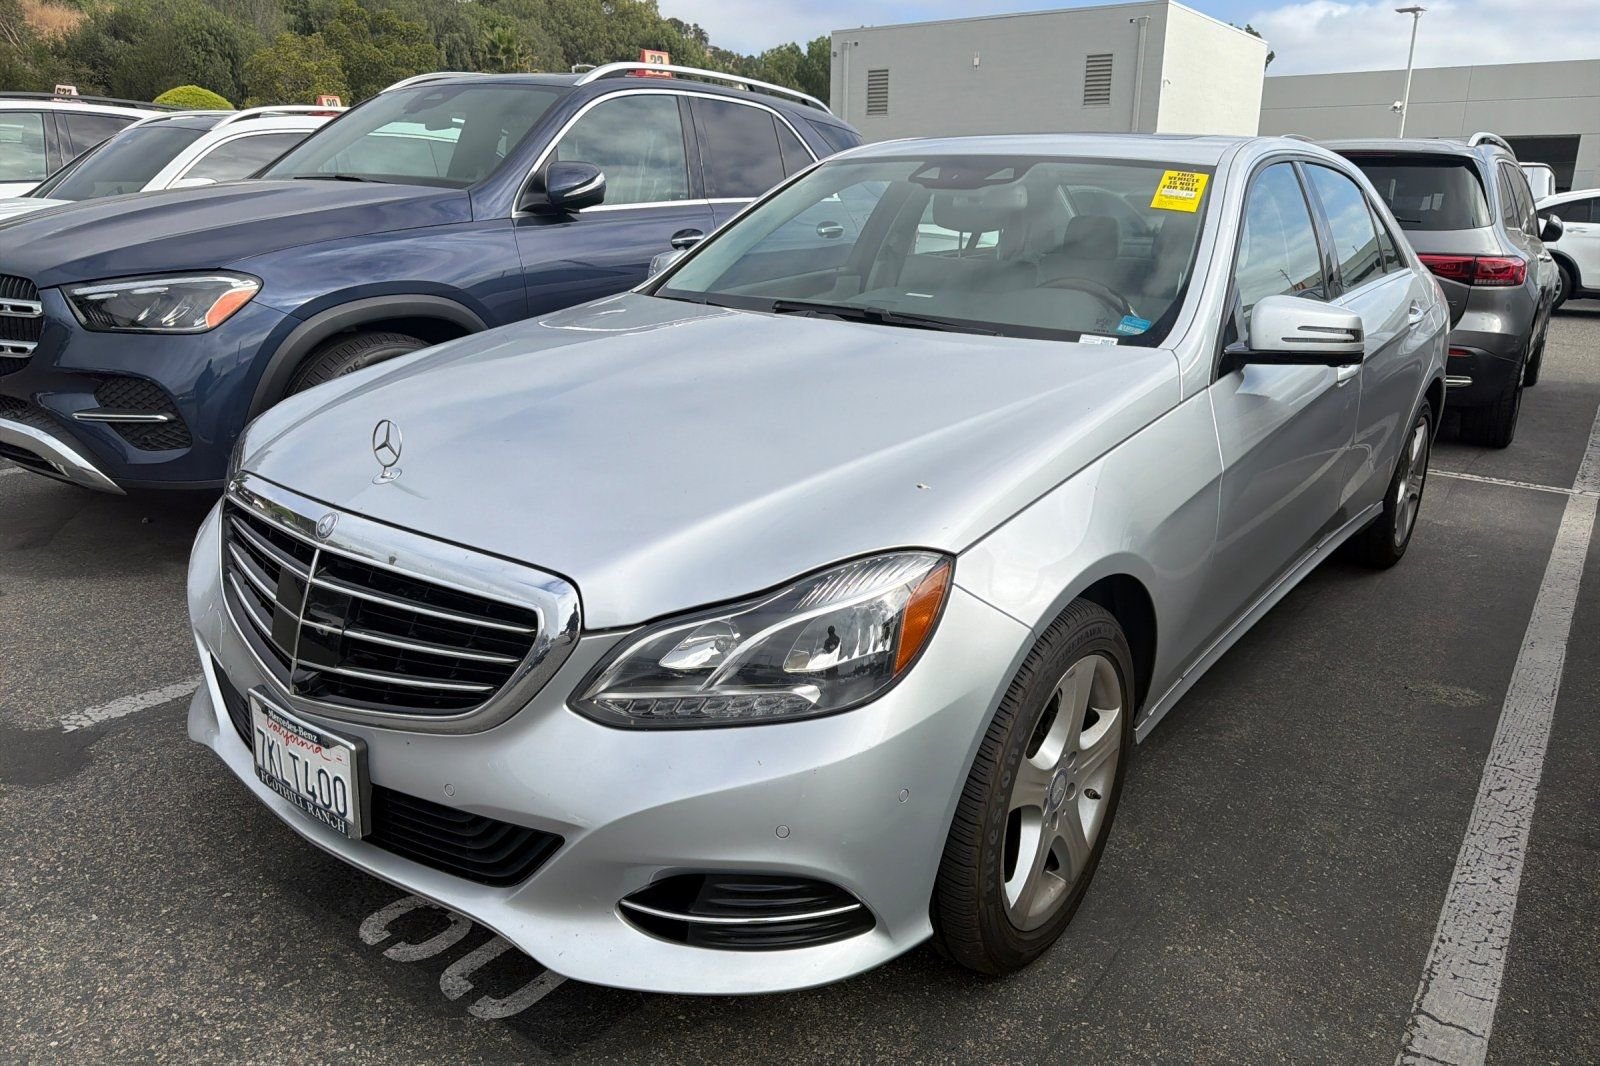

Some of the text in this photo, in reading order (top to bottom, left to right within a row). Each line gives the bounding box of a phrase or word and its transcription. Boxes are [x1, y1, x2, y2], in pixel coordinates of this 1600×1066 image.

[266, 716, 332, 762] California
[267, 709, 318, 743] Mercedes-Benz
[257, 726, 348, 819] 7KLT400
[260, 769, 346, 834] FOOTHILL RANCH
